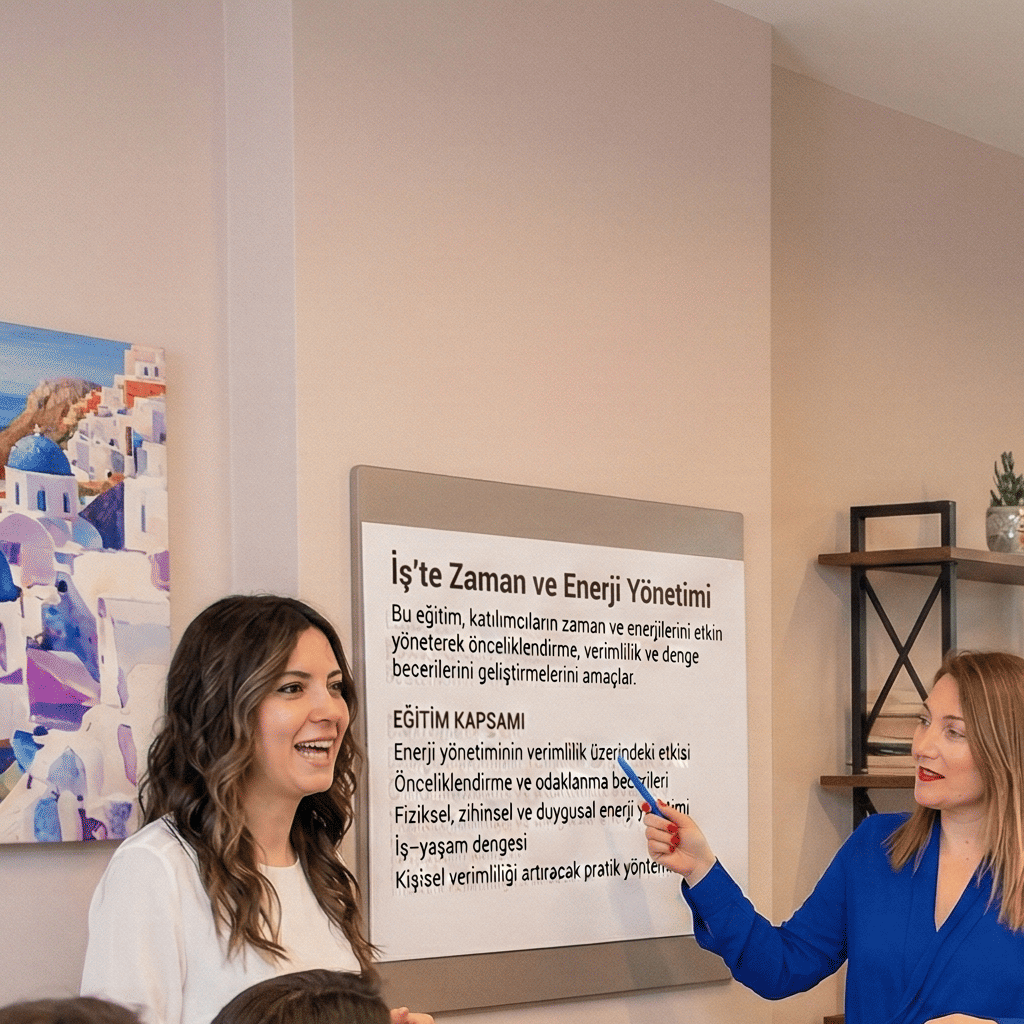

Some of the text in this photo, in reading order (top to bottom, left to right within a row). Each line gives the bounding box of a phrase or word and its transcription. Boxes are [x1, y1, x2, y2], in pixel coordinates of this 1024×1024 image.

[450, 563, 525, 594] Zaman
[533, 576, 556, 596] ve
[564, 573, 620, 607] Enerji
[627, 578, 710, 608] Yönetimi
[392, 604, 722, 642] Bu eğitim, katılımcıların zaman ve enerjilerini etkin
[392, 632, 699, 667] yöneterek önceliklendirme, verimlilik ve denge
[393, 658, 636, 688] becerilerini geliştirmelerini amaçlar.
[394, 705, 524, 729] EĞİTİM KAPSAMI
[395, 742, 690, 765] Enerji yönetiminin verimlilik üzerindeki etkisi
[395, 770, 668, 792] Önceliklendirme ve odaklanma becrileri
[396, 804, 454, 825] Fiziksel,
[459, 803, 512, 822] zihinsel
[517, 808, 532, 820] ve
[537, 801, 595, 824] duygusal
[600, 800, 633, 822] enerji
[473, 833, 526, 856] dengesi
[396, 868, 444, 893] Kişisel
[450, 864, 516, 886] verimliliği
[522, 861, 580, 881] artıracak
[585, 859, 620, 882] pratik
